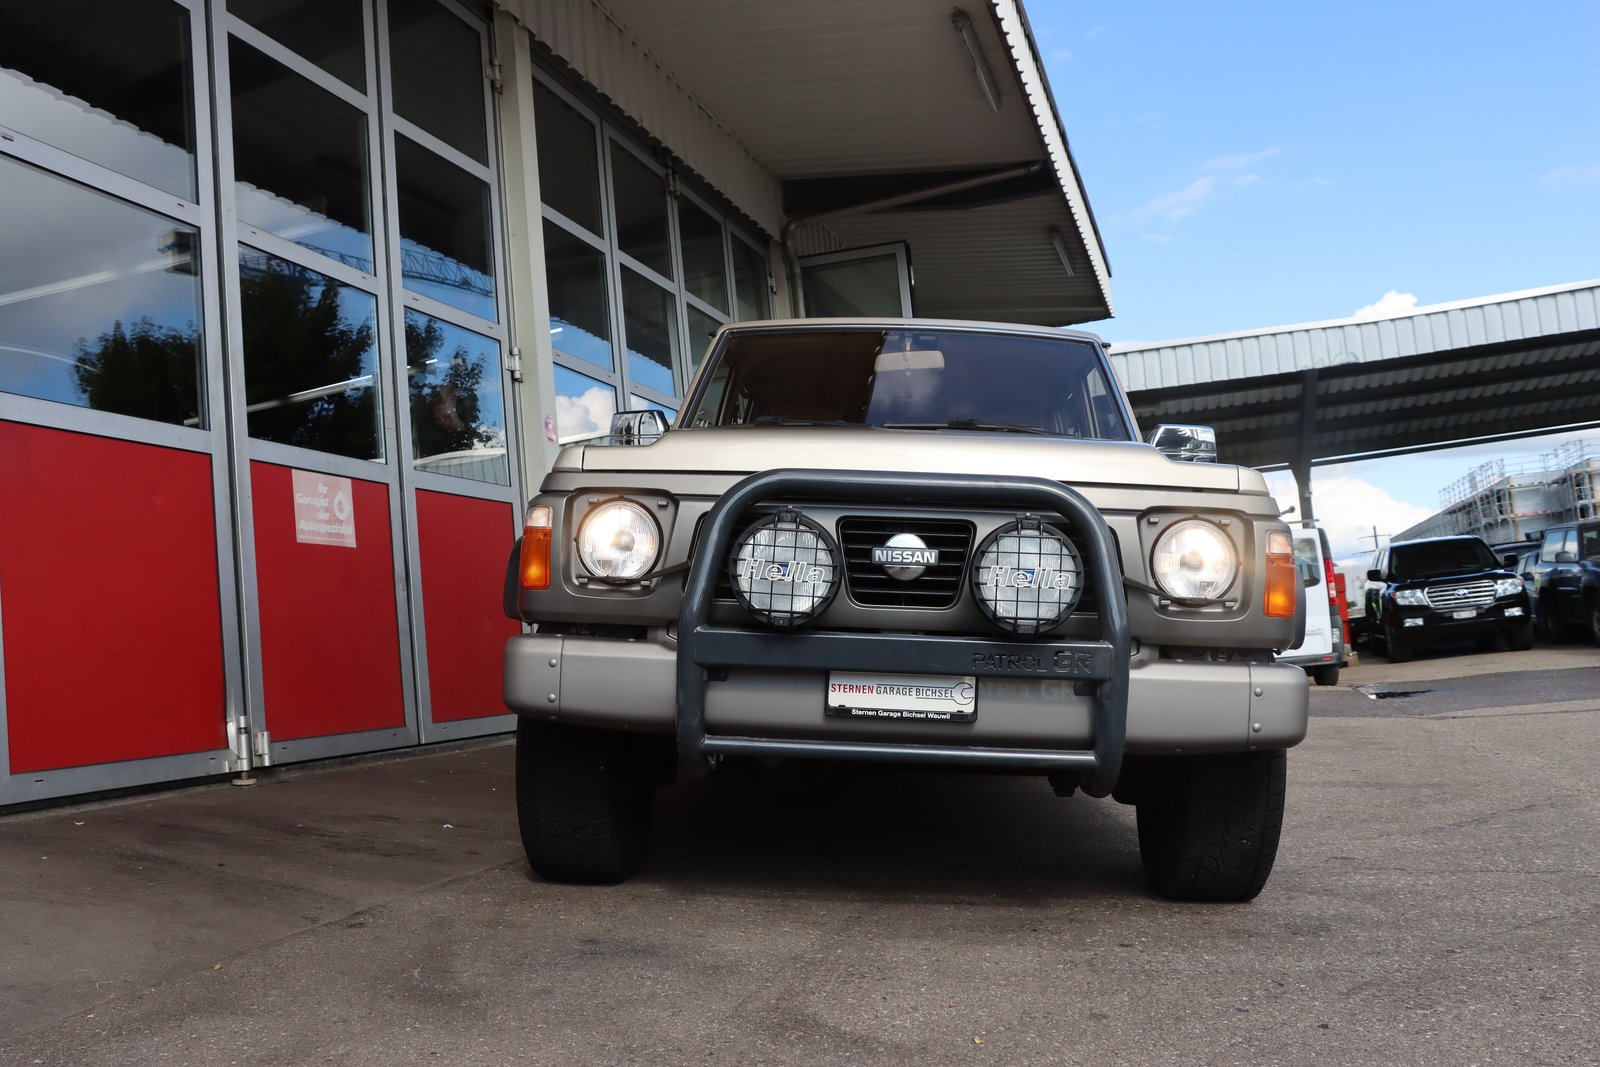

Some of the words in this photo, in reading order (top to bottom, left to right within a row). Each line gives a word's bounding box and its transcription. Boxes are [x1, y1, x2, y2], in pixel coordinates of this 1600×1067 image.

[317, 510, 329, 520] der
[875, 550, 935, 564] NISSAN
[741, 558, 825, 583] Hella
[986, 565, 1071, 589] Hella
[972, 653, 1047, 672] PATROL
[1054, 650, 1093, 673] GR
[830, 683, 874, 695] STERNEN
[876, 685, 913, 696] GARAGE
[915, 687, 954, 698] BICHSEL
[851, 708, 877, 716] Sternen
[878, 709, 902, 718] Garage
[902, 711, 926, 719] Bichsel
[927, 712, 951, 720] Wauwil
